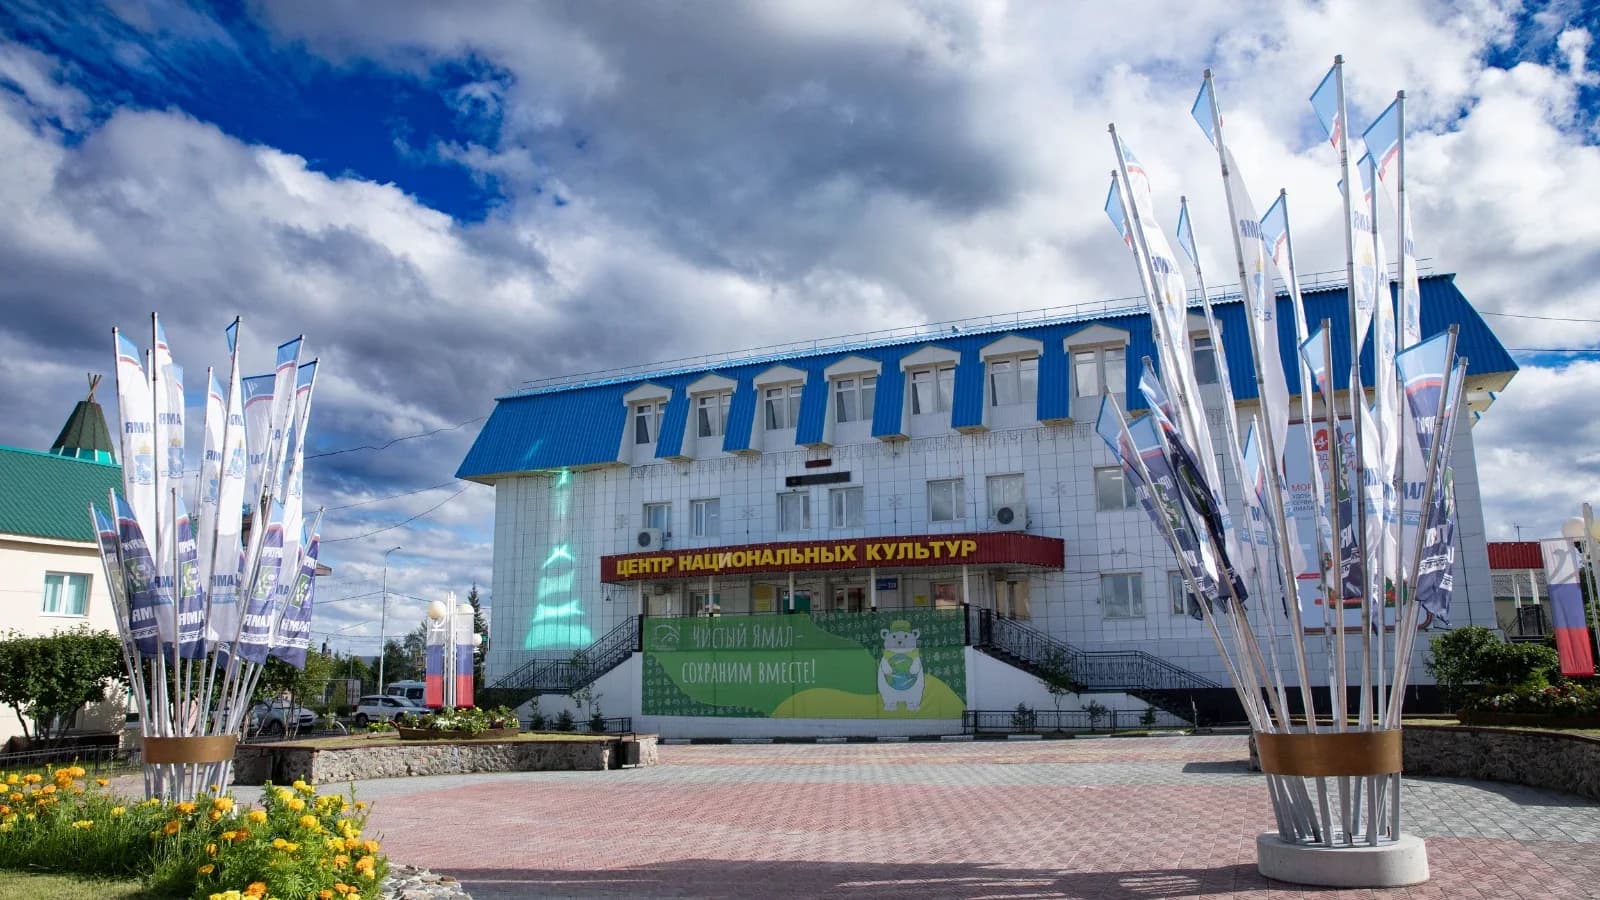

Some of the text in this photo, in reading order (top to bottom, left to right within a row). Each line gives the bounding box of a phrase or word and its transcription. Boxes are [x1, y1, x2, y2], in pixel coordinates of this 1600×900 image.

[158, 412, 182, 426] ЯМА
[125, 421, 153, 434] ЯМА
[617, 540, 977, 577] ЦЕНТР НАЦИОНАЛЬНЫХ КУЛЬТУР
[132, 606, 155, 622] ЯМ
[682, 659, 816, 684] СОХРАНИМ ВМЕСТЕ!
